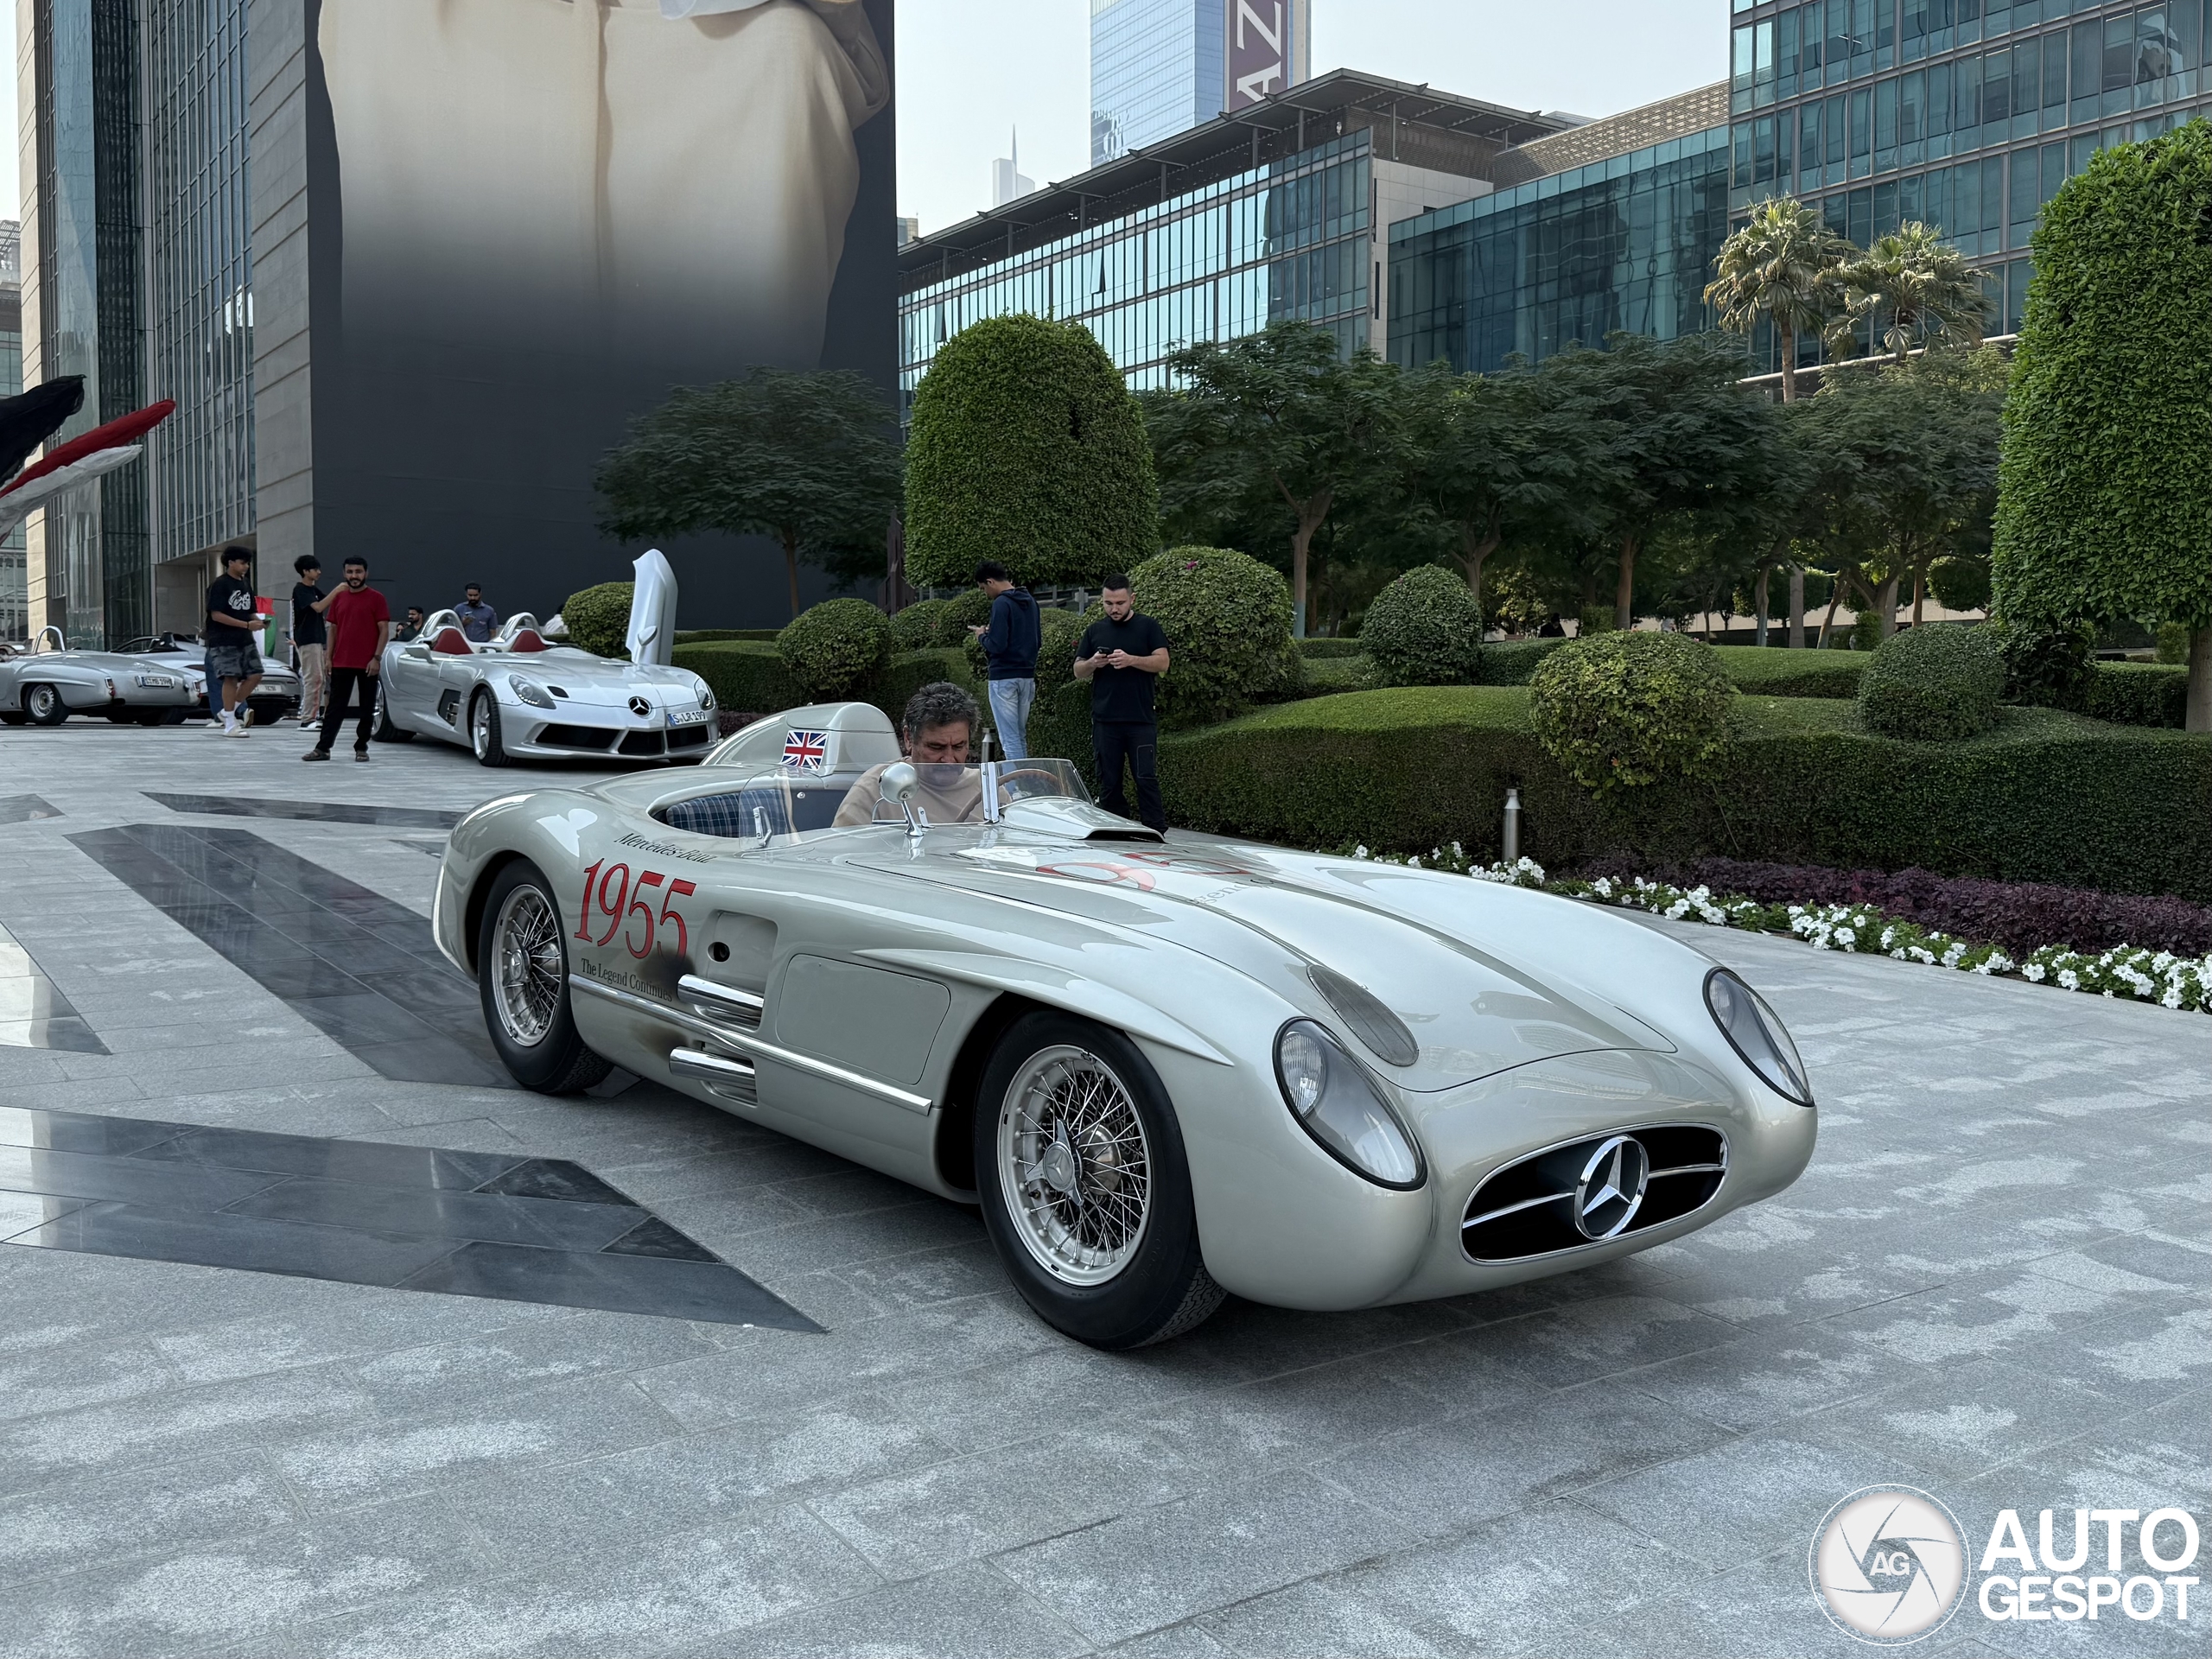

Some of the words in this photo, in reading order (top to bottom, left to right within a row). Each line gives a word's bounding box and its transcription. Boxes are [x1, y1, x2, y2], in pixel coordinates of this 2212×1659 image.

[673, 715, 680, 723] S
[681, 713, 694, 721] LR
[692, 711, 706, 720] 199
[613, 833, 717, 863] Mercedes-Benz
[574, 858, 696, 962] 1955
[582, 957, 597, 976] The
[598, 963, 627, 986] Legend
[630, 975, 672, 1002] Continues
